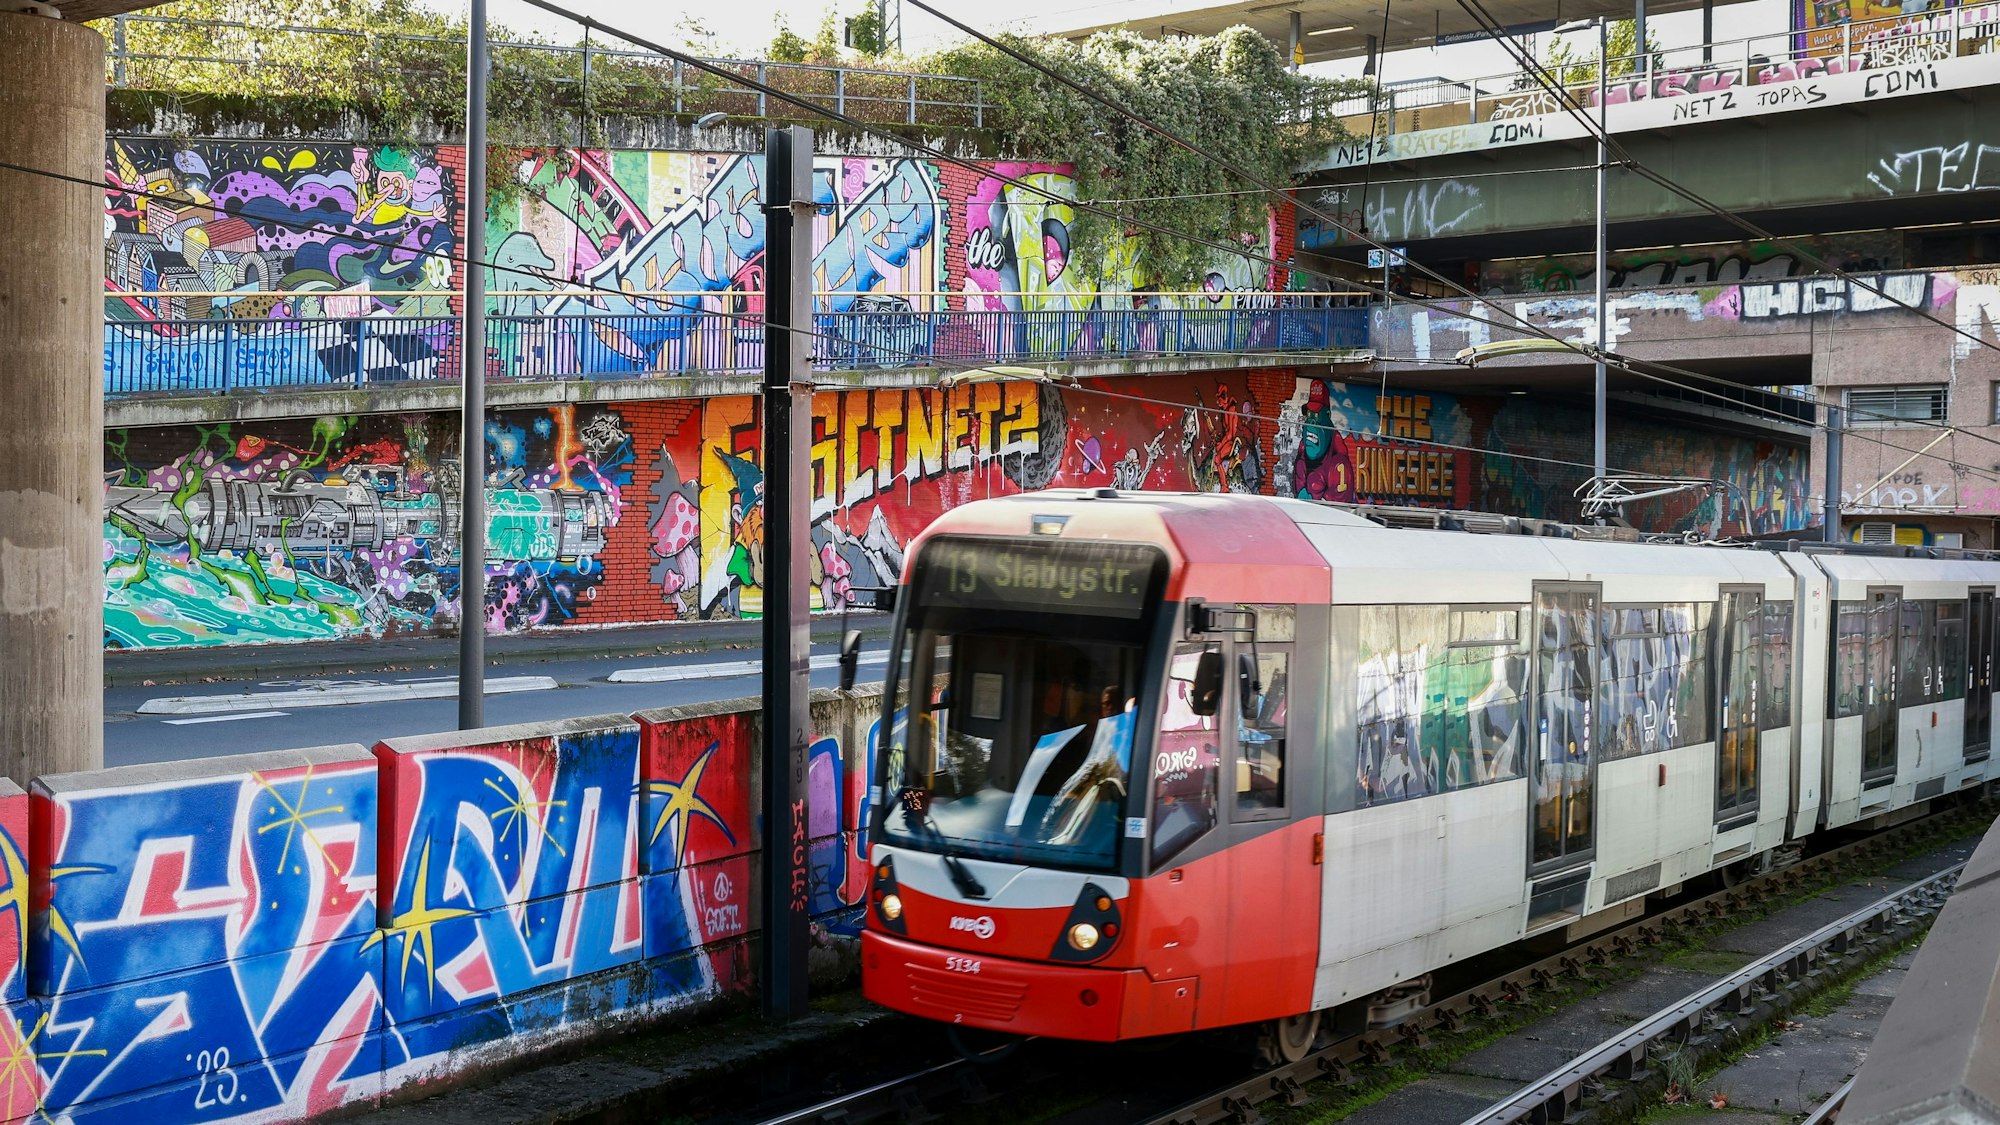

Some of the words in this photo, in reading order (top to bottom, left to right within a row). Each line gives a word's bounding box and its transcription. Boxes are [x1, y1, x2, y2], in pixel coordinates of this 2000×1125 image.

[1813, 33, 1833, 45] Hufe
[1836, 23, 1878, 39] klppern,
[1673, 92, 1737, 121] NETZ
[1757, 84, 1827, 107] TOPAS
[1337, 139, 1389, 165] NETZ
[966, 227, 1004, 269] the
[1375, 395, 1432, 439] THE
[950, 551, 977, 593] 13
[994, 552, 1138, 599] Slabystr.
[945, 957, 981, 974] 5134
[953, 1013, 963, 1024] 2
